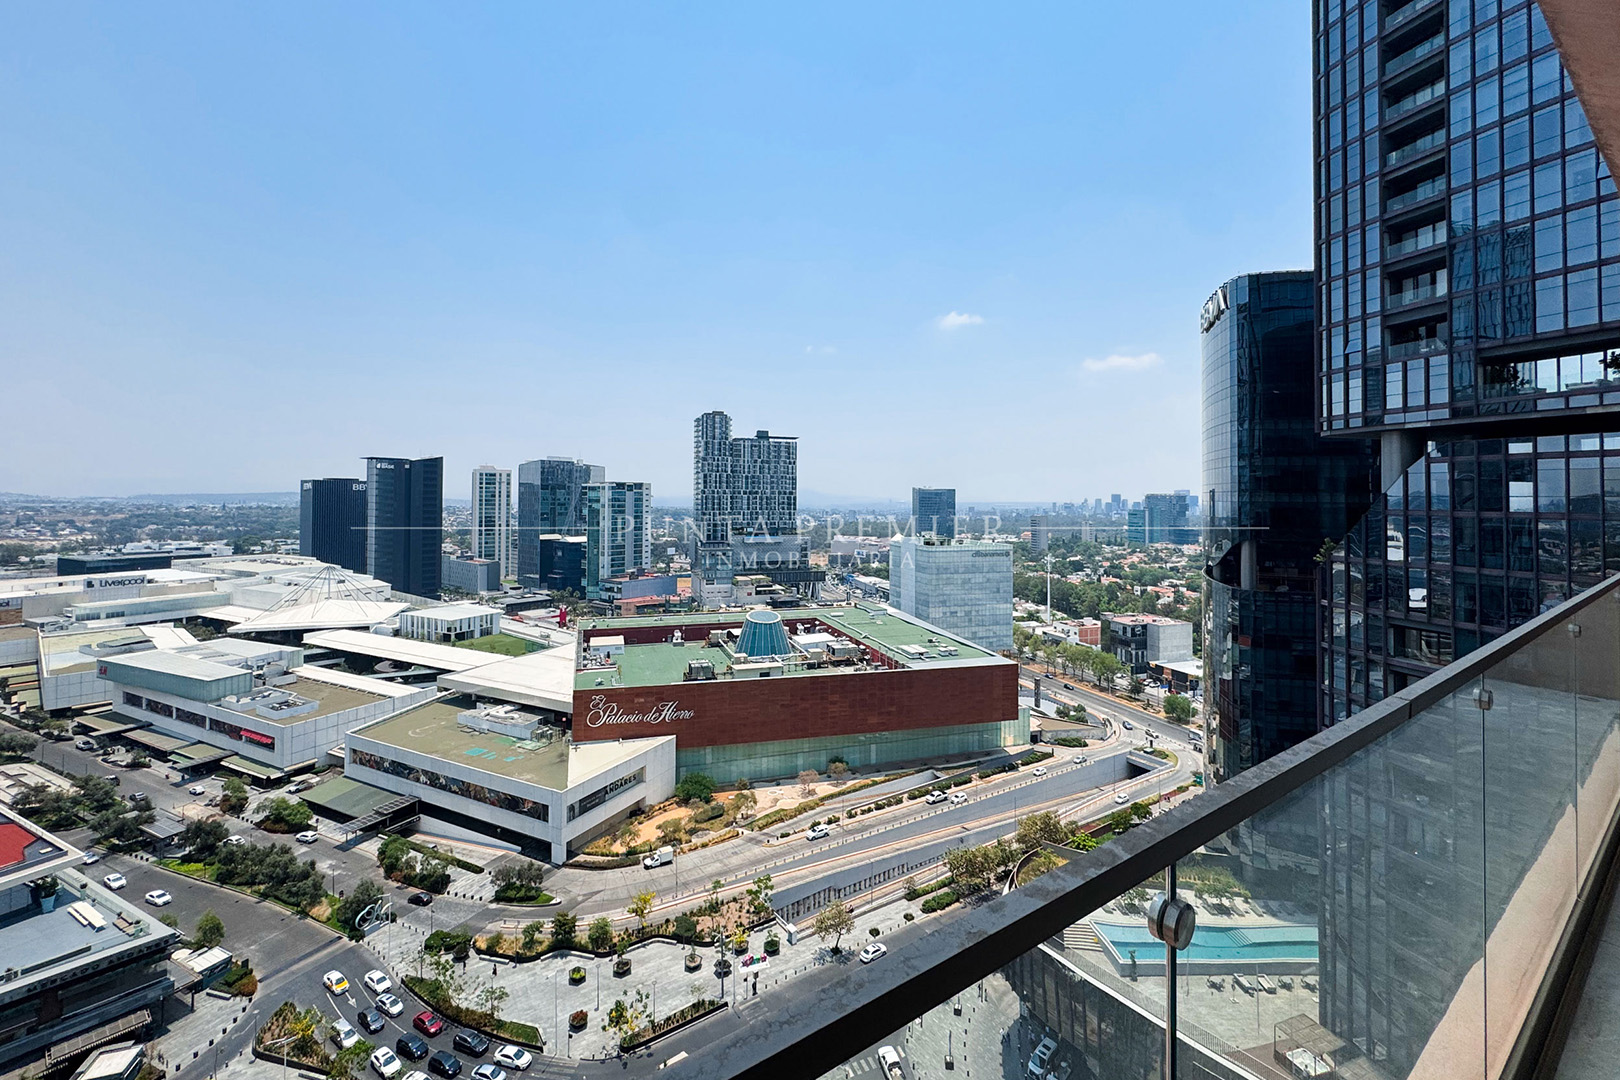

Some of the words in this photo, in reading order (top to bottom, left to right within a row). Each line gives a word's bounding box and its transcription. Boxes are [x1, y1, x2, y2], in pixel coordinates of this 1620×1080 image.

[100, 577, 145, 587] Liverpool
[589, 694, 606, 710] El
[586, 702, 643, 728] Palacio
[643, 706, 661, 724] de
[656, 700, 695, 723] Hierro
[604, 773, 637, 797] ANDARES
